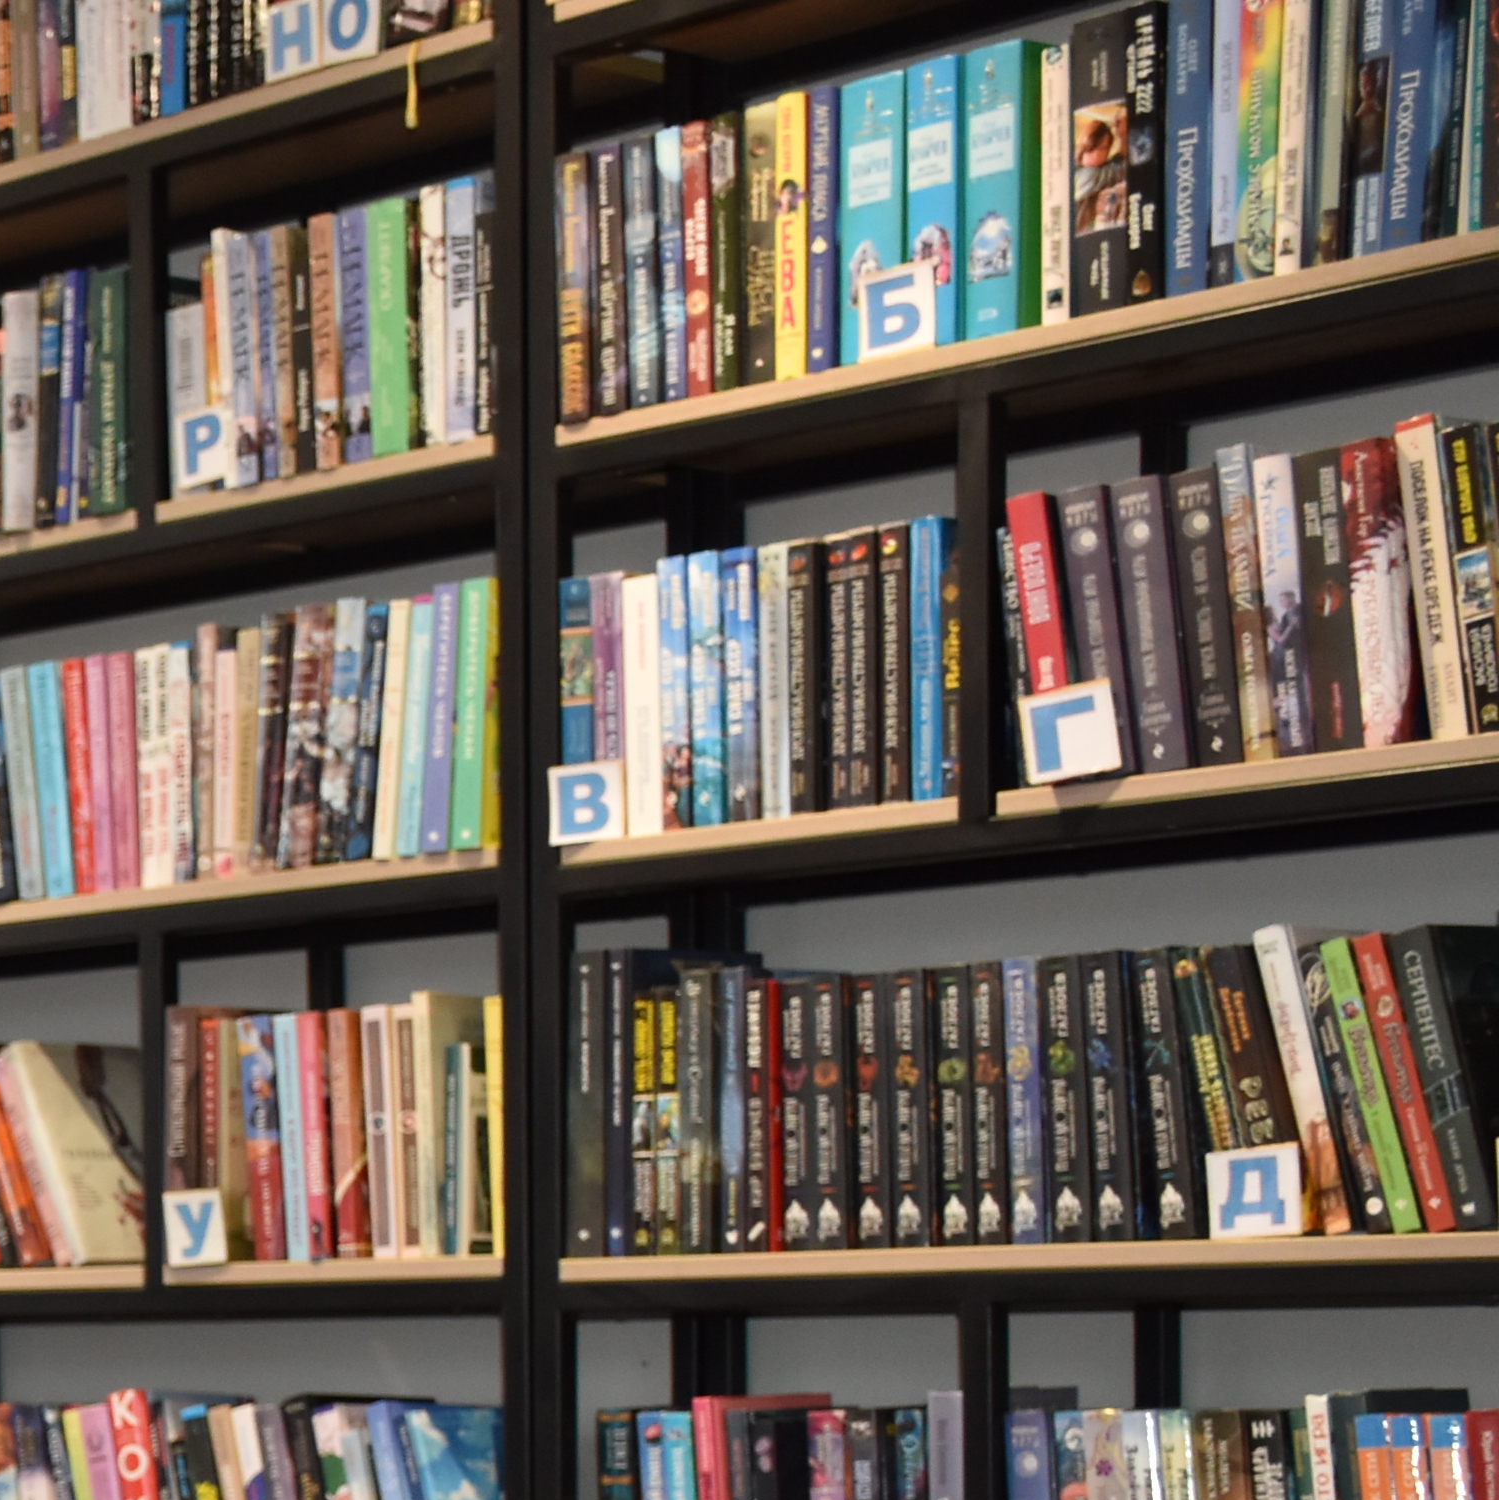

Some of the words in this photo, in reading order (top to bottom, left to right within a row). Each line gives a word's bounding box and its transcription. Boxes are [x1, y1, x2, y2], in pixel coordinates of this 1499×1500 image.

[271, 4, 312, 74] Н
[326, 0, 370, 52] О
[866, 273, 922, 350] Б
[184, 412, 221, 482] Р
[1408, 459, 1430, 523] ПОСЕЛОК
[1416, 526, 1433, 548] НА
[1417, 548, 1437, 589] РЕКЕ
[1421, 586, 1445, 648] ОРЕДЕЖ
[1030, 693, 1099, 776] Г
[558, 772, 611, 837] В
[1401, 950, 1445, 1072] СЕРПЕНТЕС
[1219, 1157, 1286, 1231] Д
[175, 1200, 216, 1257] У
